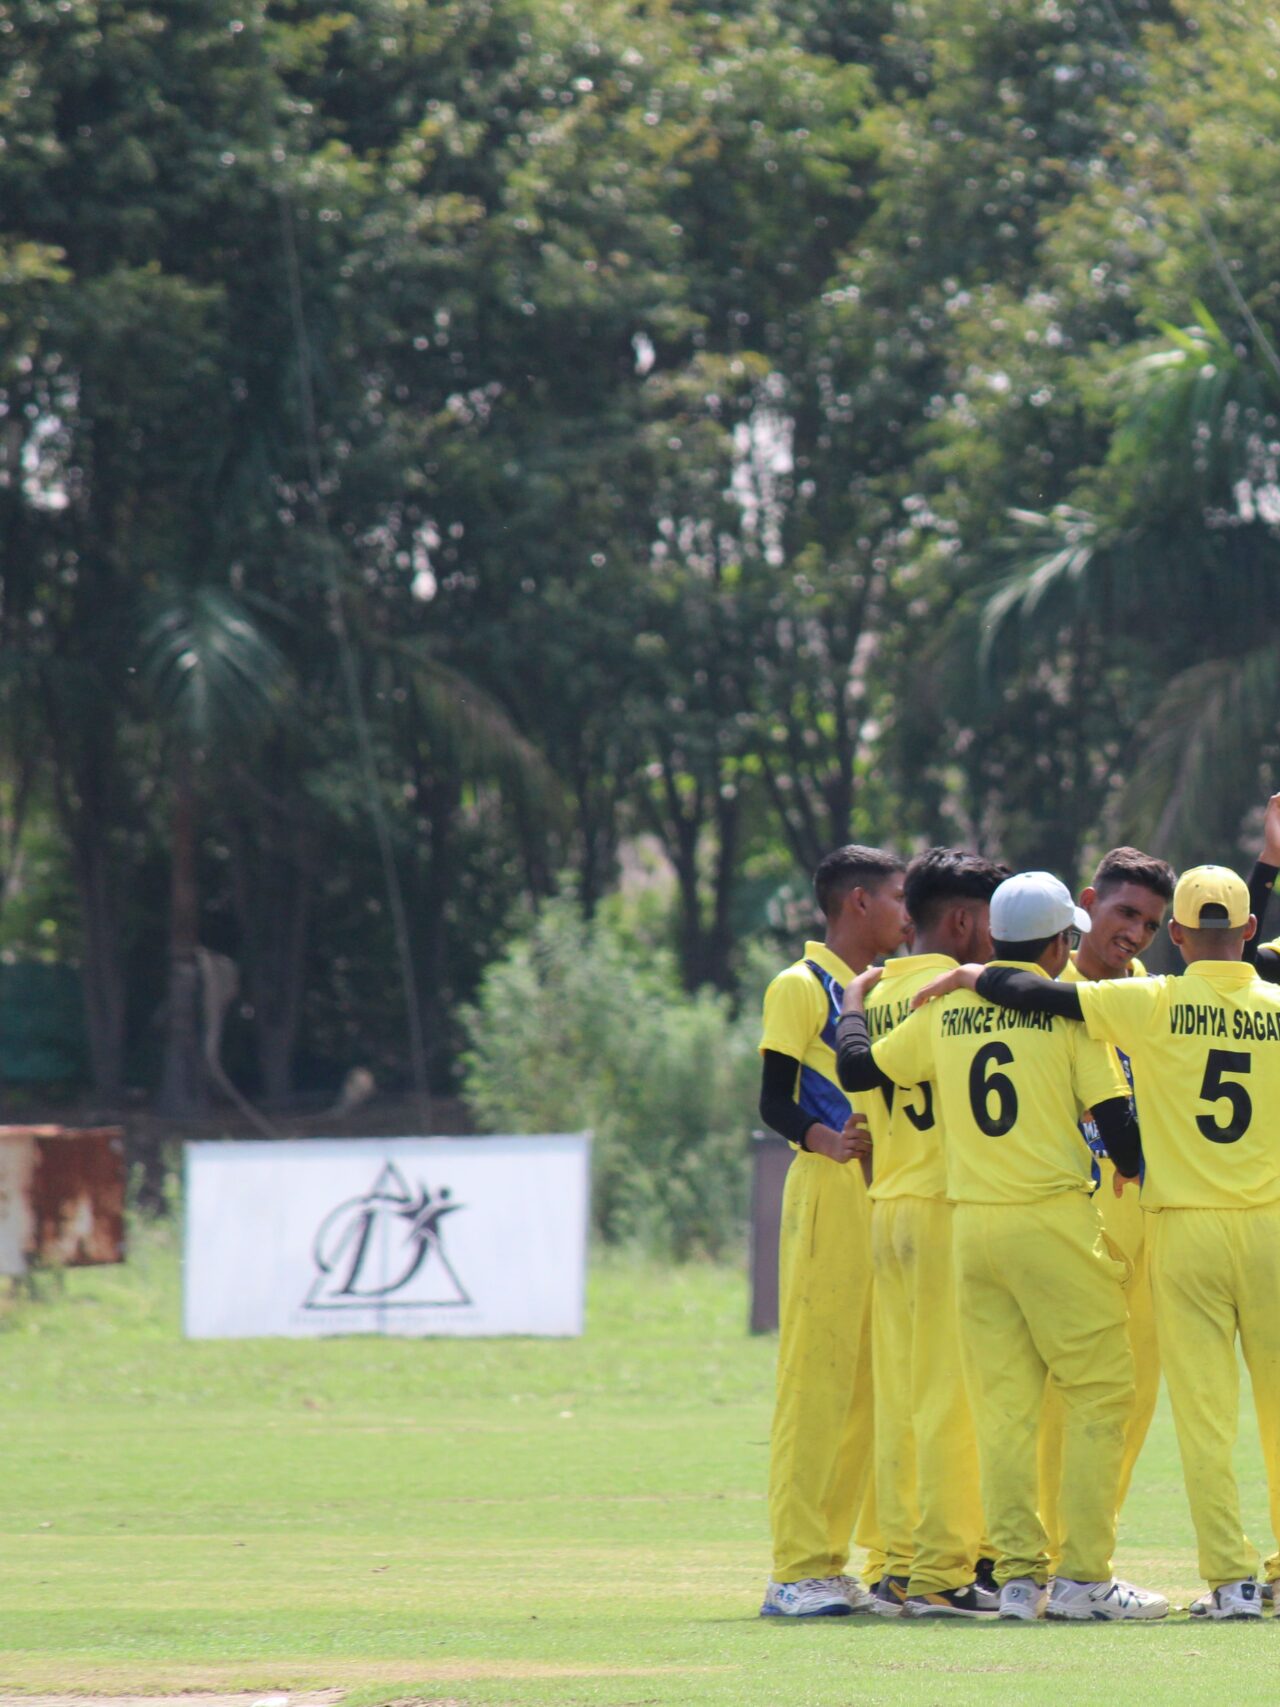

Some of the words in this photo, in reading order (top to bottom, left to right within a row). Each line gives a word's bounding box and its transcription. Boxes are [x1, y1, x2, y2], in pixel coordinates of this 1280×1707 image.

[941, 1006, 995, 1037] PRINCE
[997, 1006, 1053, 1032] KUMAR
[1170, 1004, 1228, 1038] VIDHYA
[969, 1041, 1018, 1137] 6
[1195, 1048, 1252, 1144] 5
